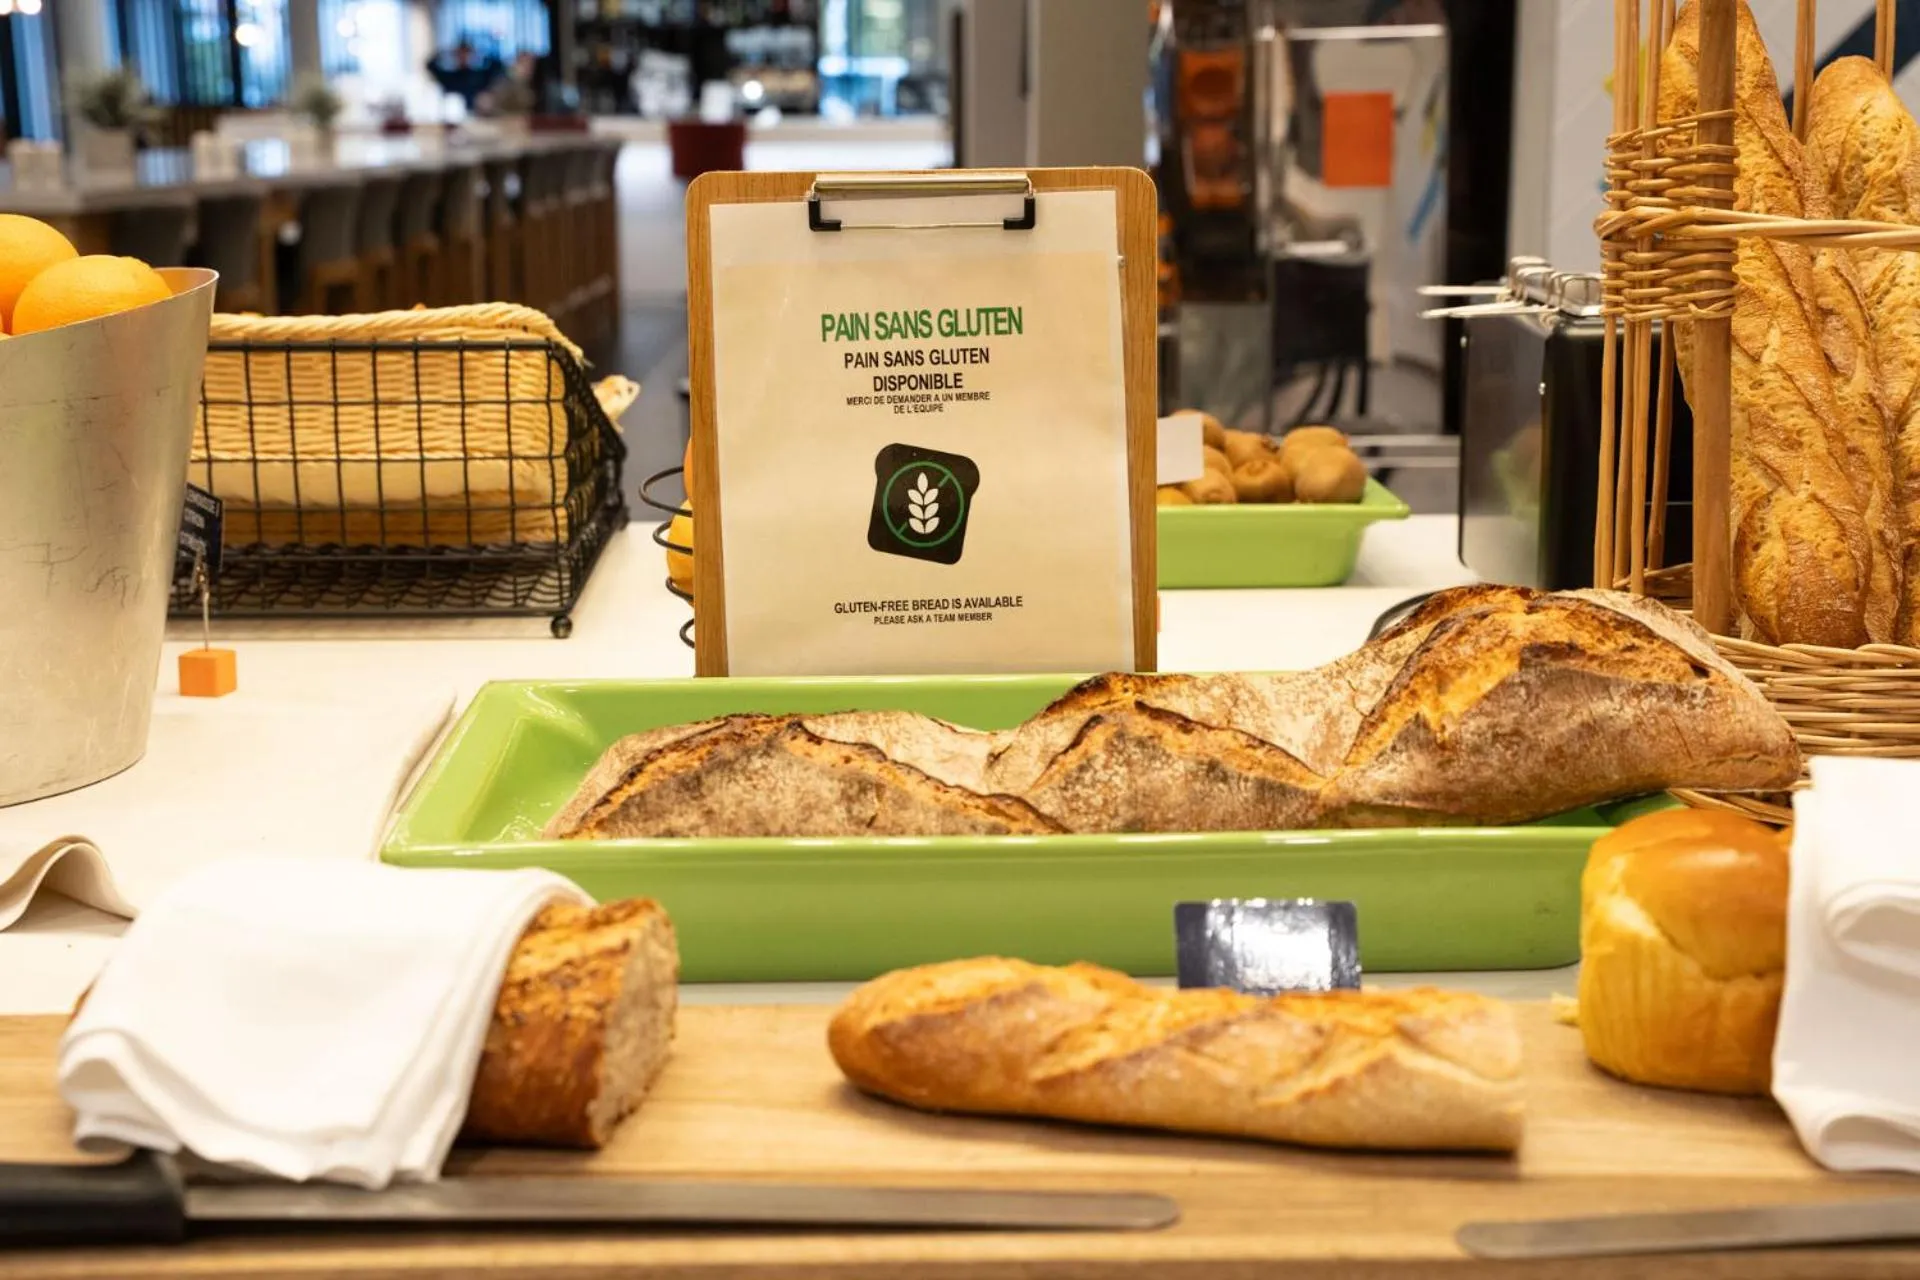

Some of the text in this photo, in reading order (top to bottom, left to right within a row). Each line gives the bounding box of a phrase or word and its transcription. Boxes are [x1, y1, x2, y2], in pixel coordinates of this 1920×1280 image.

[821, 306, 1023, 342] PAIN SANS GLUTEN
[844, 347, 990, 369] PAIN SANS GLUTEN
[873, 373, 963, 392] DISPONIBLE
[846, 396, 873, 406] MERCI
[874, 395, 885, 405] DE
[886, 394, 933, 404] DEMANDER
[942, 393, 953, 402] UN
[955, 391, 990, 401] MEMBRE
[894, 404, 905, 414] DE
[834, 595, 1023, 614] GLUTEN-FREE BREAD IS AVAILABLE
[874, 612, 993, 625] PLEASE ASK A TEAM MEMBER
